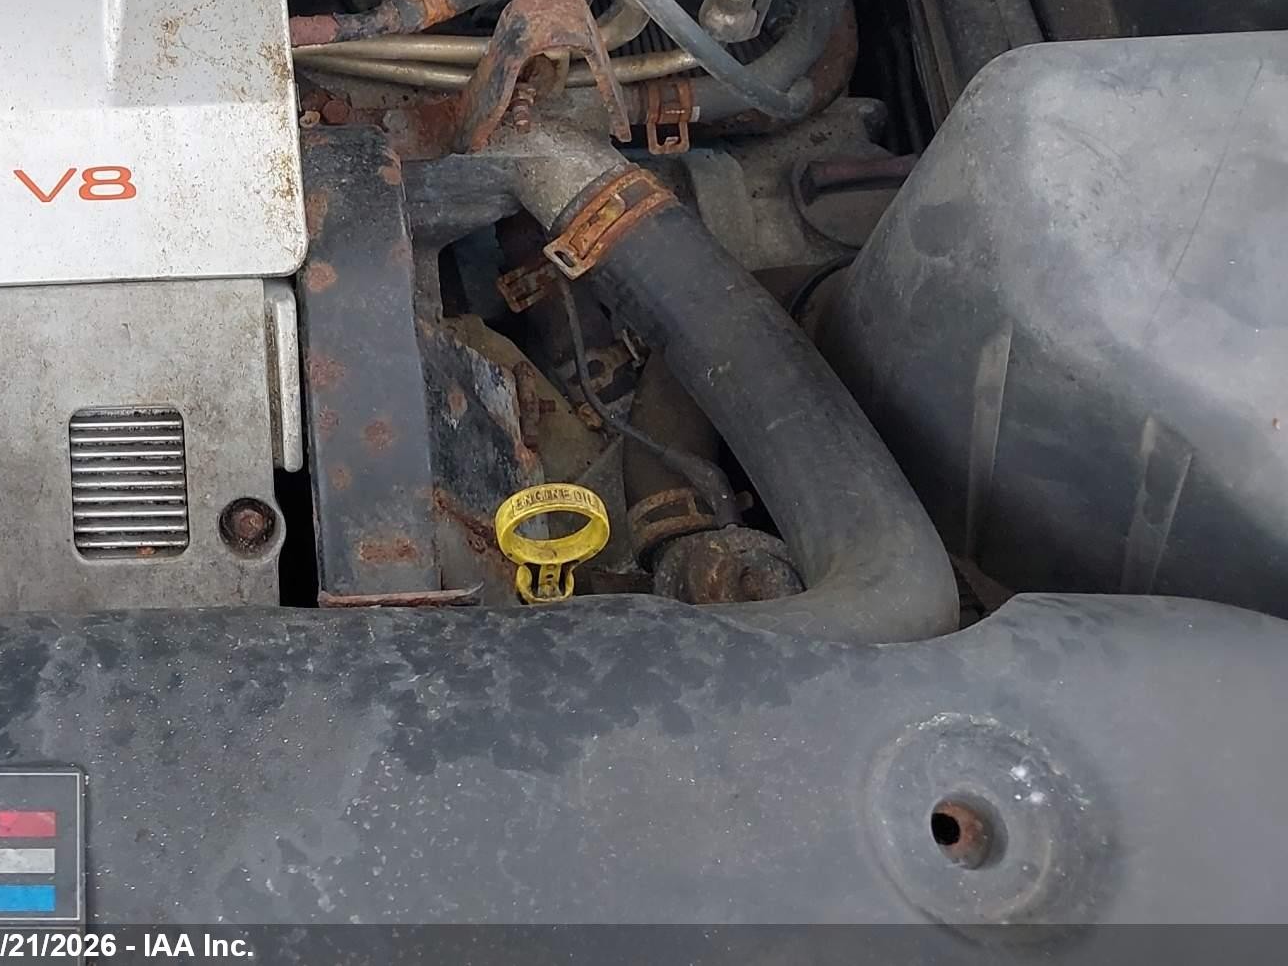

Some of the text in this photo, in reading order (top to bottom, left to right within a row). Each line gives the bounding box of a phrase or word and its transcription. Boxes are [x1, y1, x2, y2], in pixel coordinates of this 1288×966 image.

[12, 166, 138, 203] V8
[516, 488, 597, 510] ENGINE OIL
